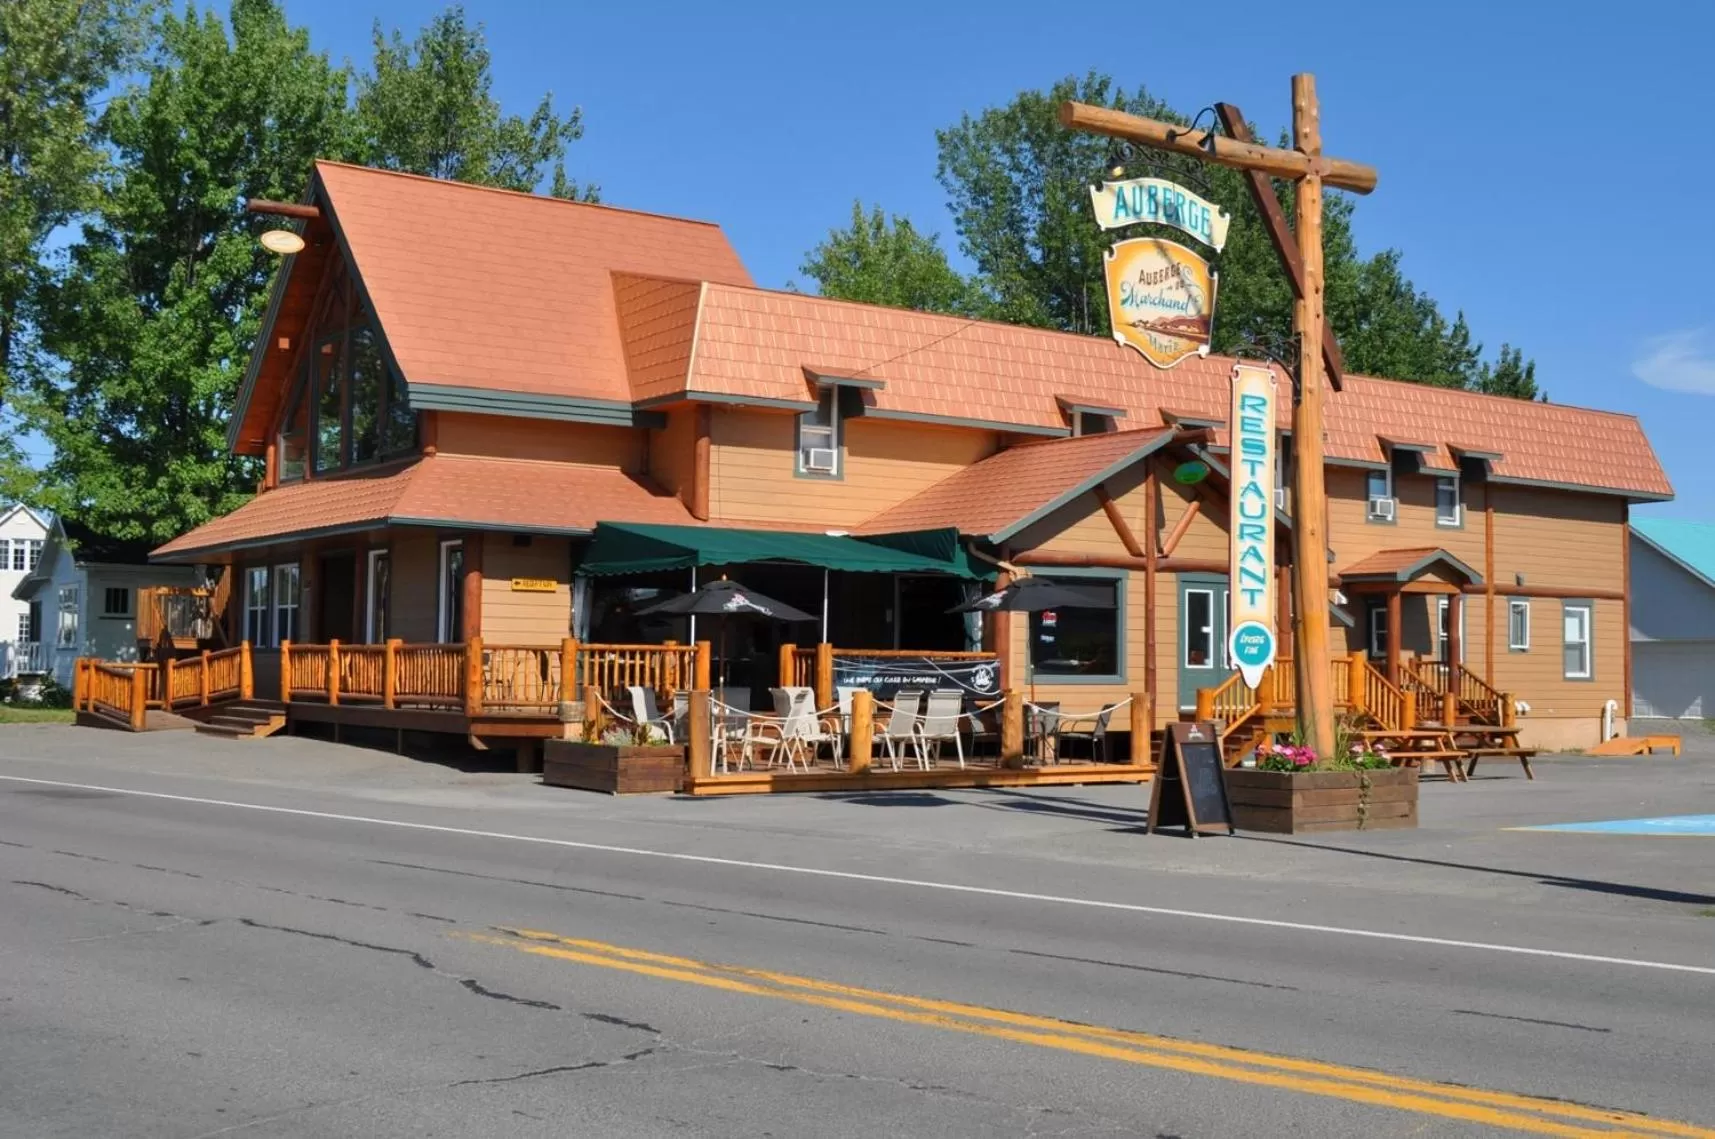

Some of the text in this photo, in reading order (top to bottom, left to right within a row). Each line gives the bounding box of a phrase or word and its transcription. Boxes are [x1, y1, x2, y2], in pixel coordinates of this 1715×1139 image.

[1114, 184, 1213, 238] AUBERGE
[1138, 262, 1181, 286] AUBERGE
[1120, 279, 1198, 314] Marchand
[1238, 393, 1269, 607] RESTAURANT
